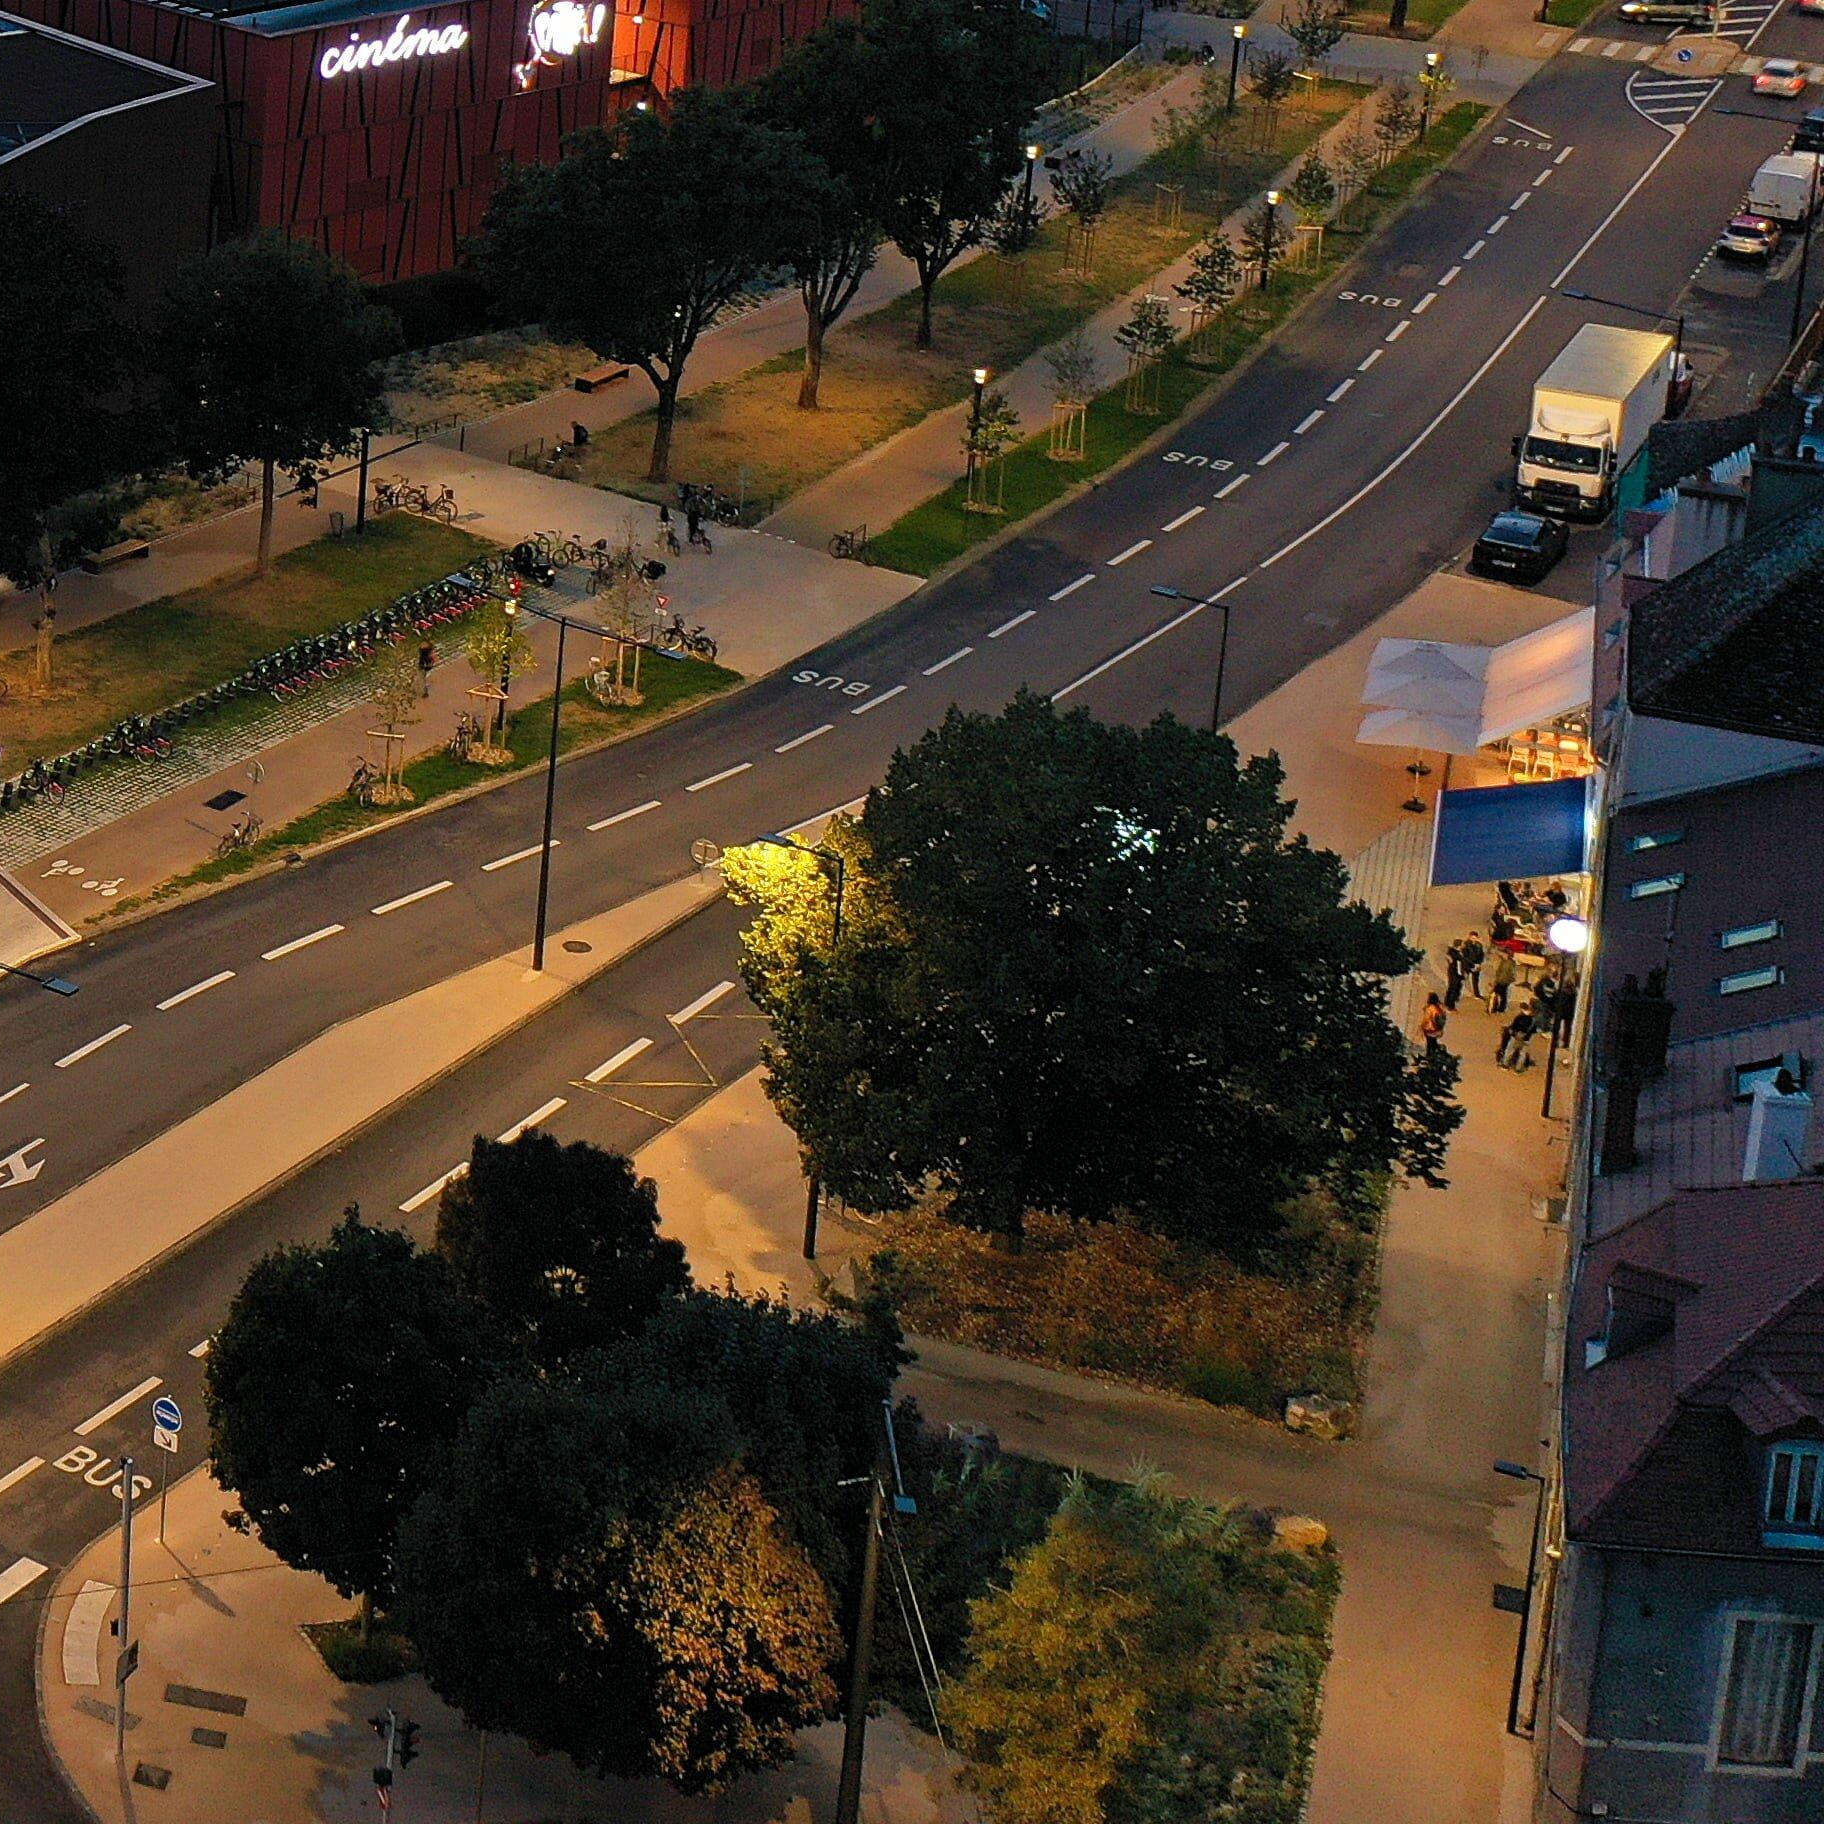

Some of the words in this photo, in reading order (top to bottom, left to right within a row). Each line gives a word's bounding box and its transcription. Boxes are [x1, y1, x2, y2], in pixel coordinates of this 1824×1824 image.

[320, 14, 468, 79] cinéma
[1338, 291, 1402, 308] BUS
[1162, 451, 1234, 471] BUS
[792, 670, 871, 696] BUS
[52, 1445, 153, 1500] BUS
